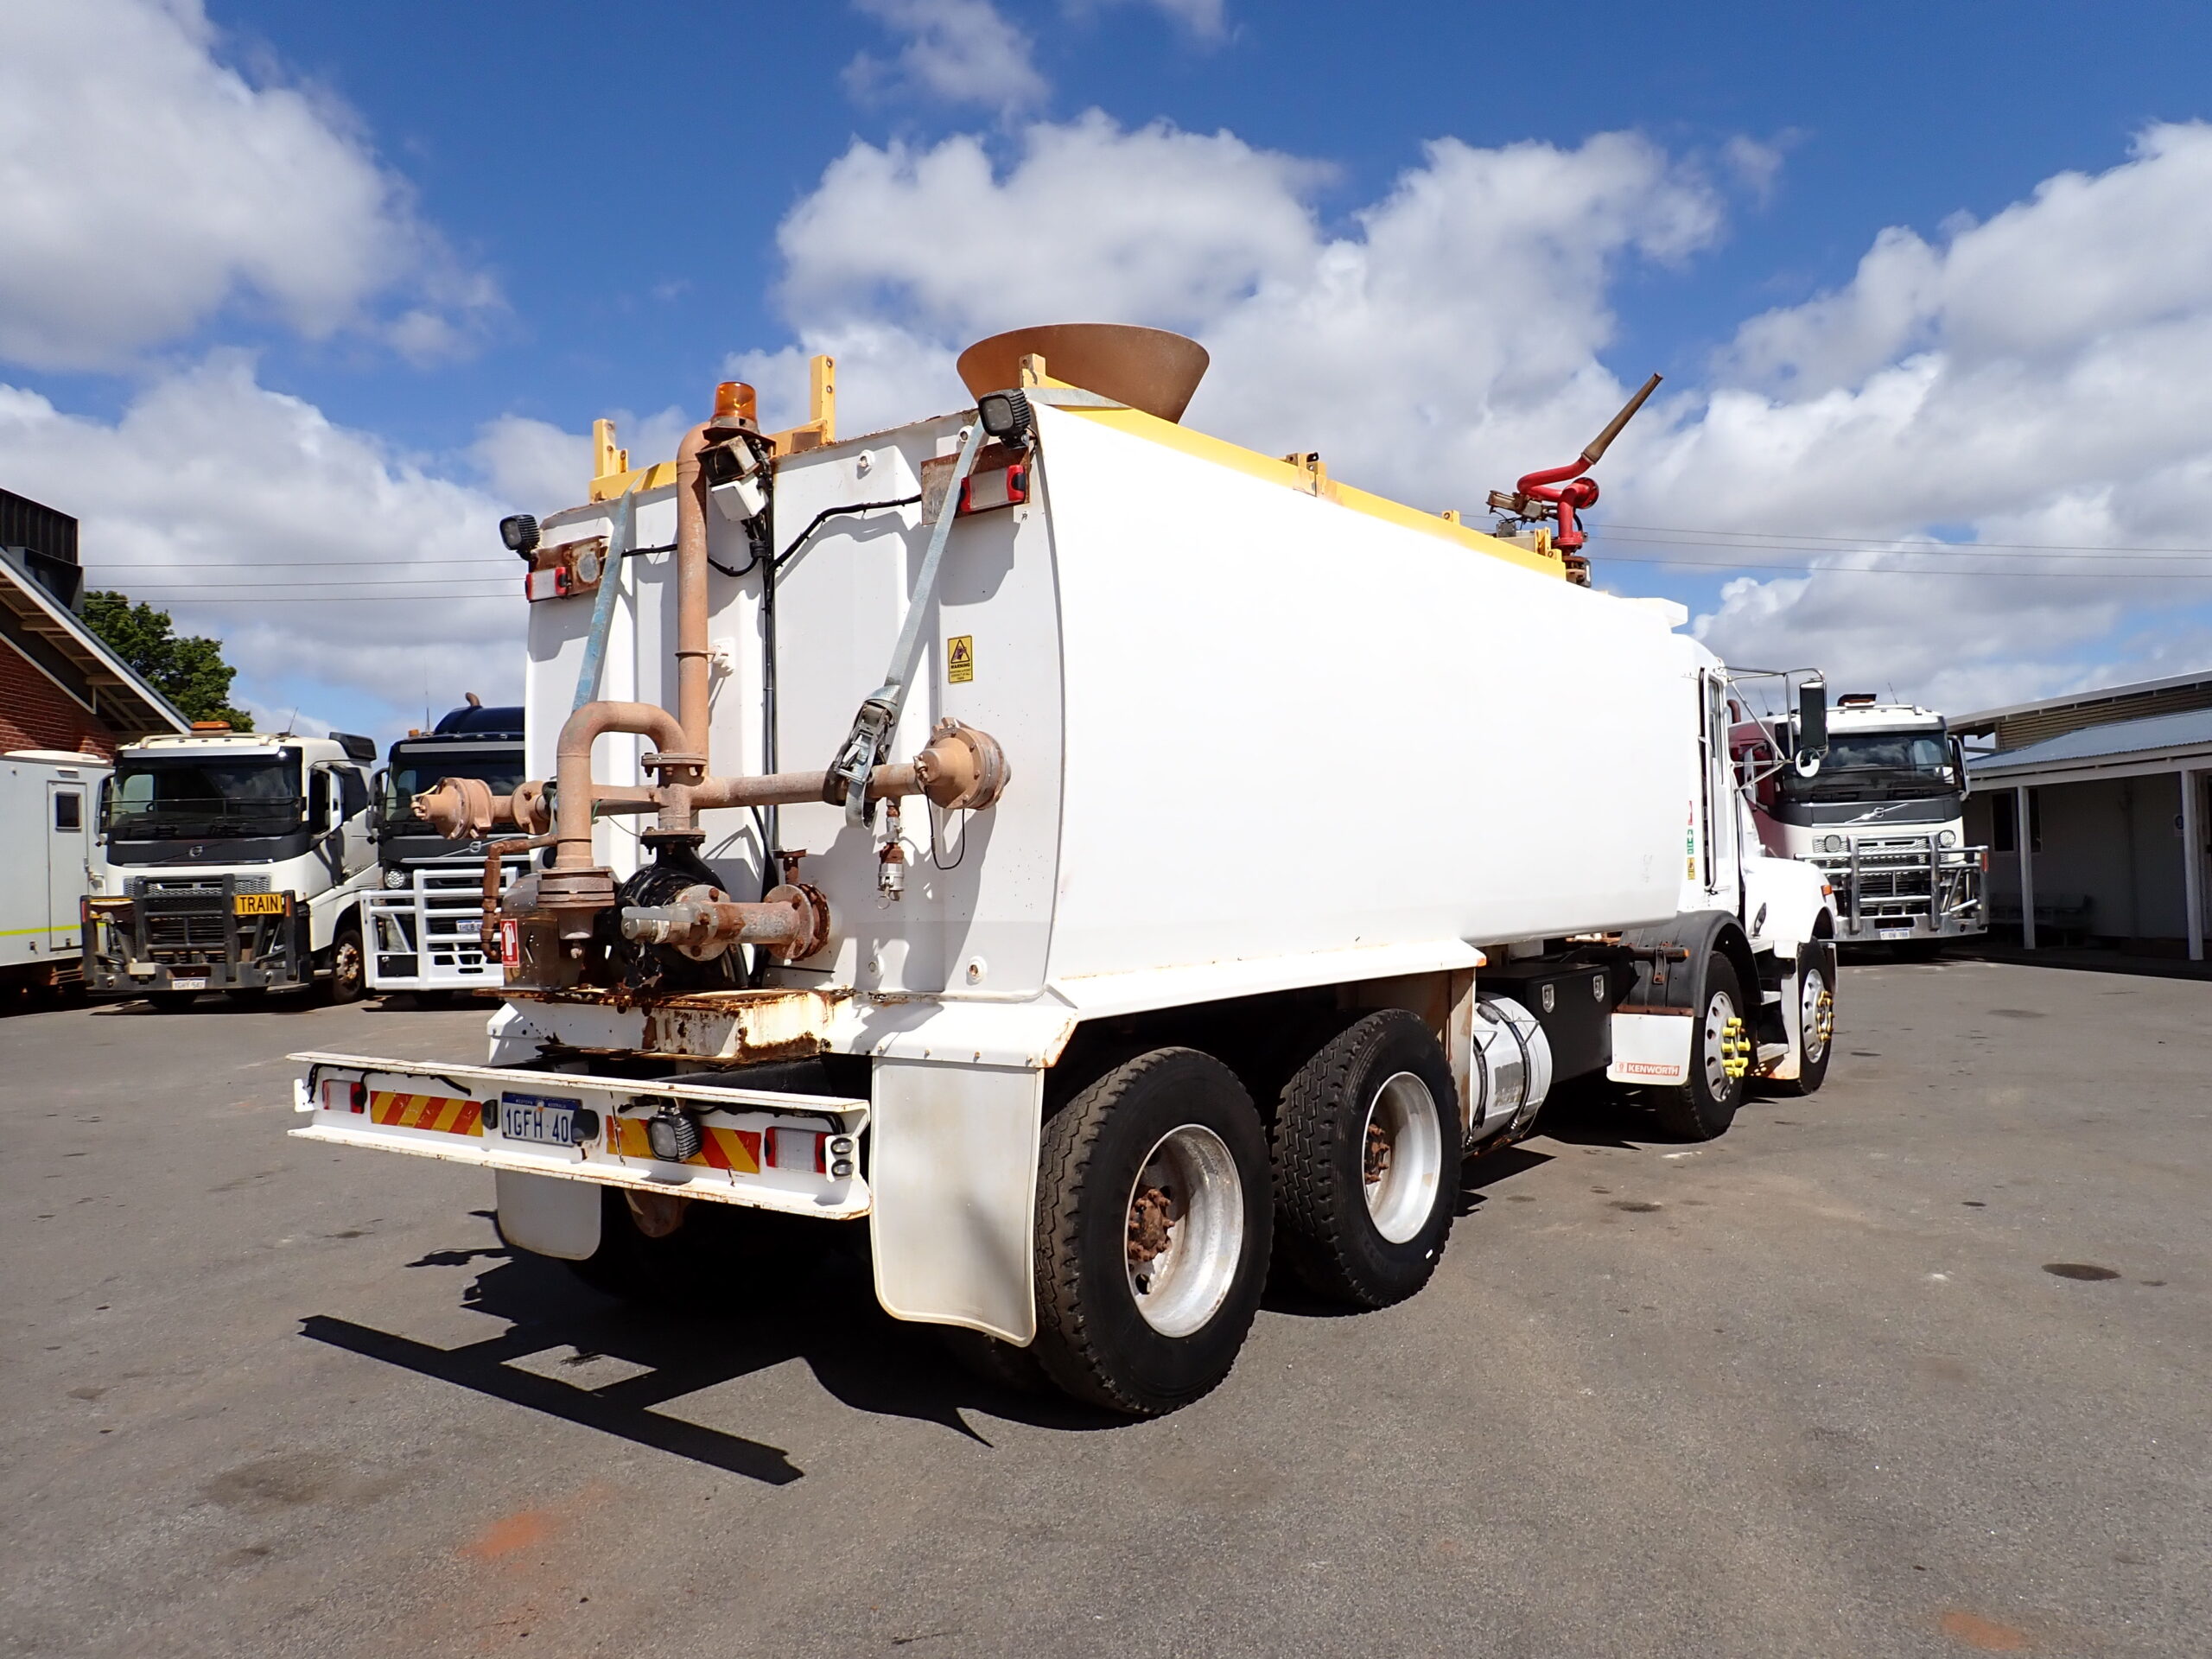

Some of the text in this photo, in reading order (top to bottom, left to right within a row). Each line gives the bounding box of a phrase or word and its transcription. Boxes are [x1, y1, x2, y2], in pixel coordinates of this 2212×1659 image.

[239, 895, 279, 912] TRAIN
[1628, 1064, 1679, 1075] KENWORTH
[506, 1108, 570, 1143] 1GFH 40
